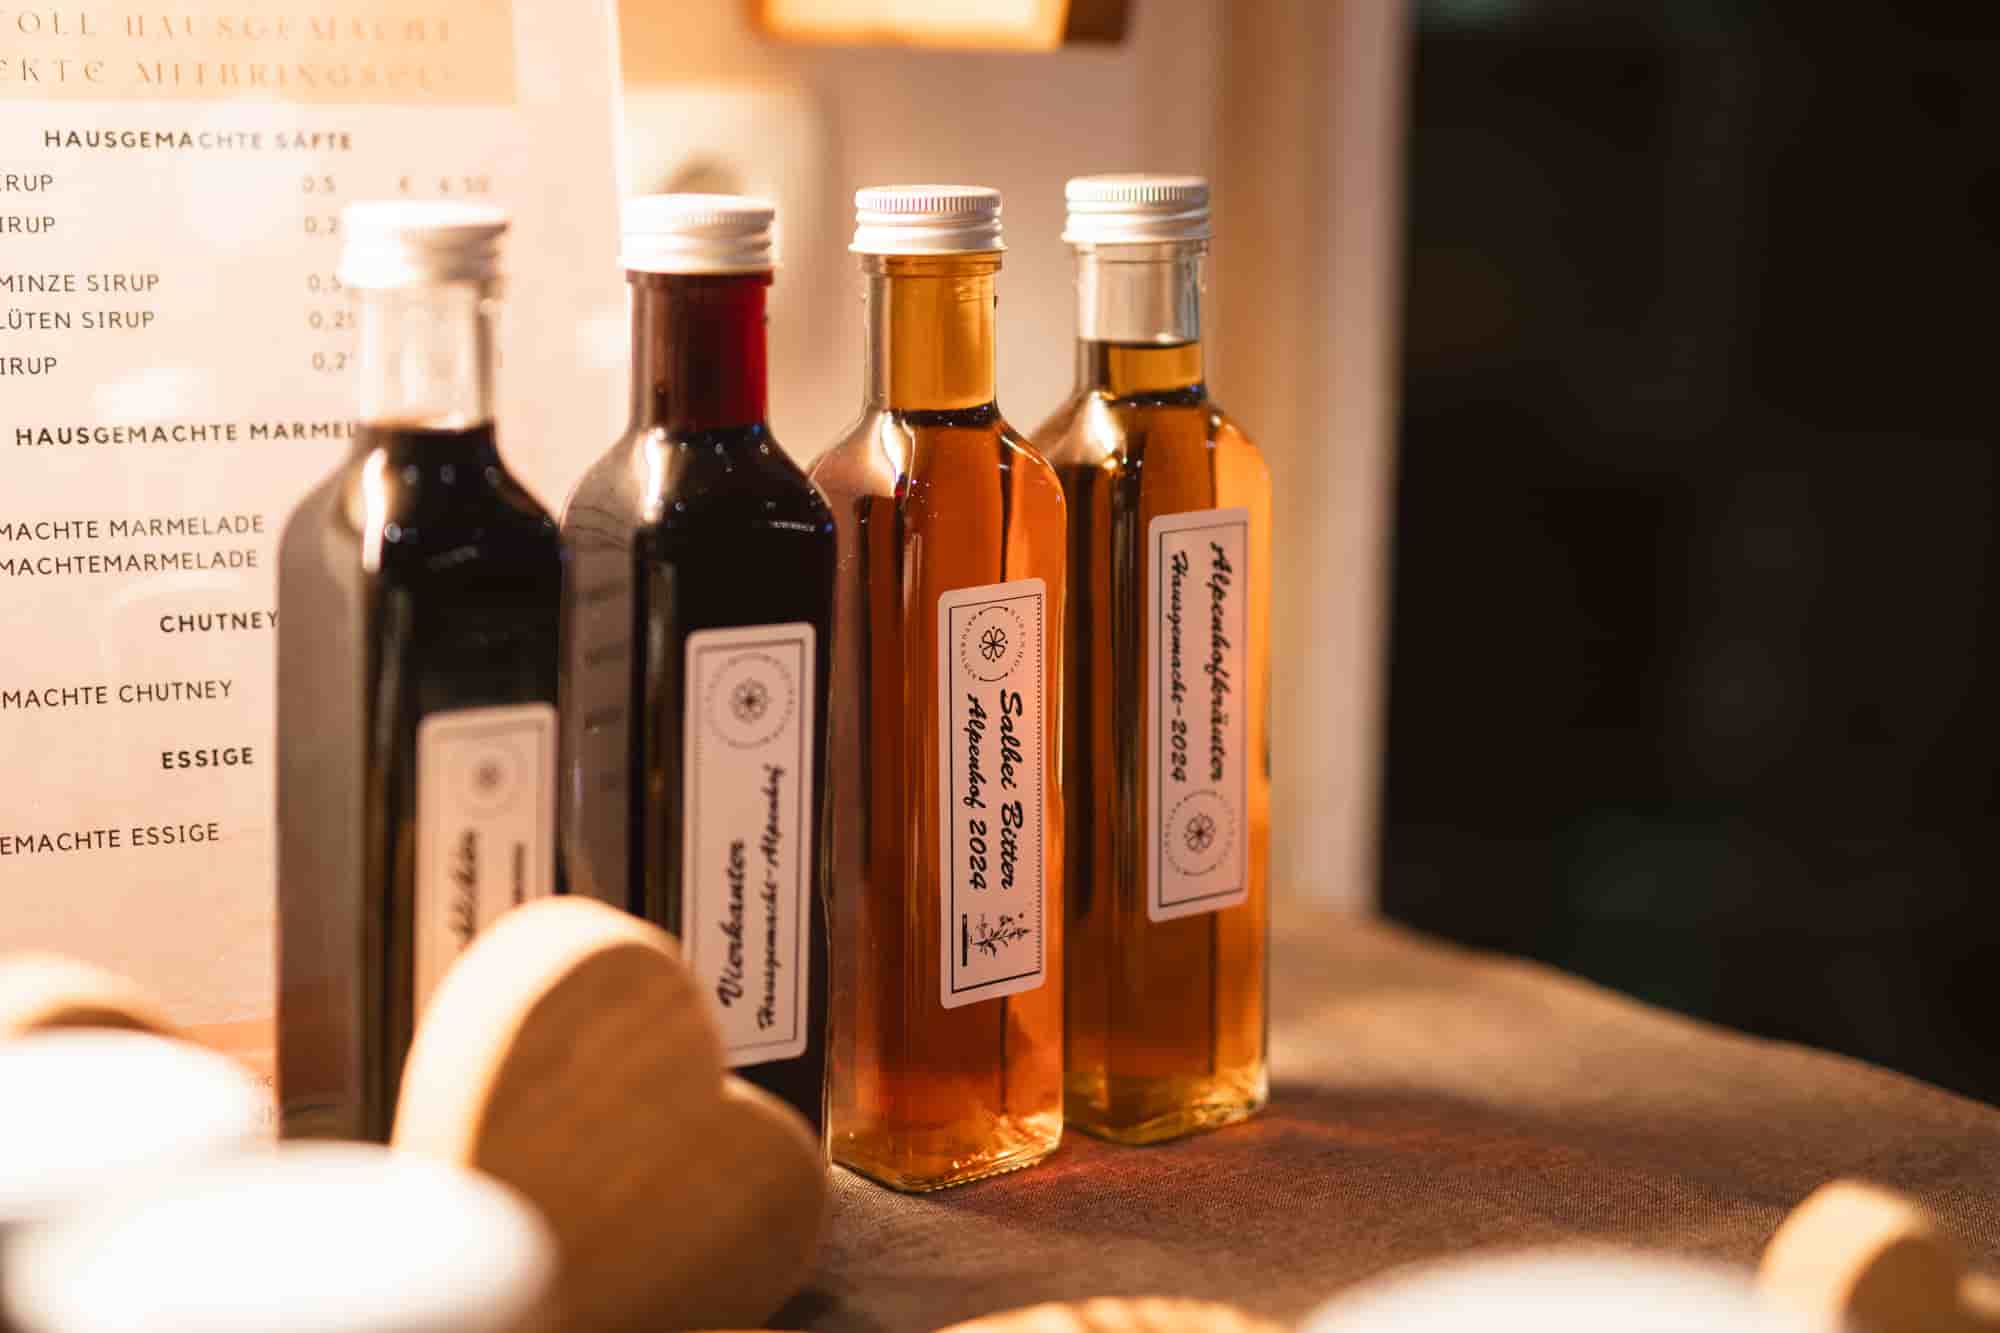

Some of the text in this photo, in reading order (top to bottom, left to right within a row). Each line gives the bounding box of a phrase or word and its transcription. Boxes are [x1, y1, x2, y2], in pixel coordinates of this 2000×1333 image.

[0, 8, 98, 35] OLL
[44, 130, 262, 150] HAUSGEMACHTE
[0, 174, 53, 192] RUP
[87, 274, 159, 292] SIRUP
[82, 311, 155, 329] SIRUP
[16, 424, 238, 446] HAUSGEMACHTE
[110, 515, 264, 537] MARMELADE
[160, 611, 279, 632] CHUTNEY
[3, 680, 232, 709] MACHTE CHUTNEY
[963, 693, 986, 809] Alpenhof
[1000, 688, 1023, 790] Salbei
[162, 747, 254, 769] ESSIGE
[0, 823, 220, 855] EMACHTE ESSIGE
[1000, 799, 1023, 890] Bitter
[968, 819, 987, 891] 2024
[717, 839, 745, 1008] Vierkanter
